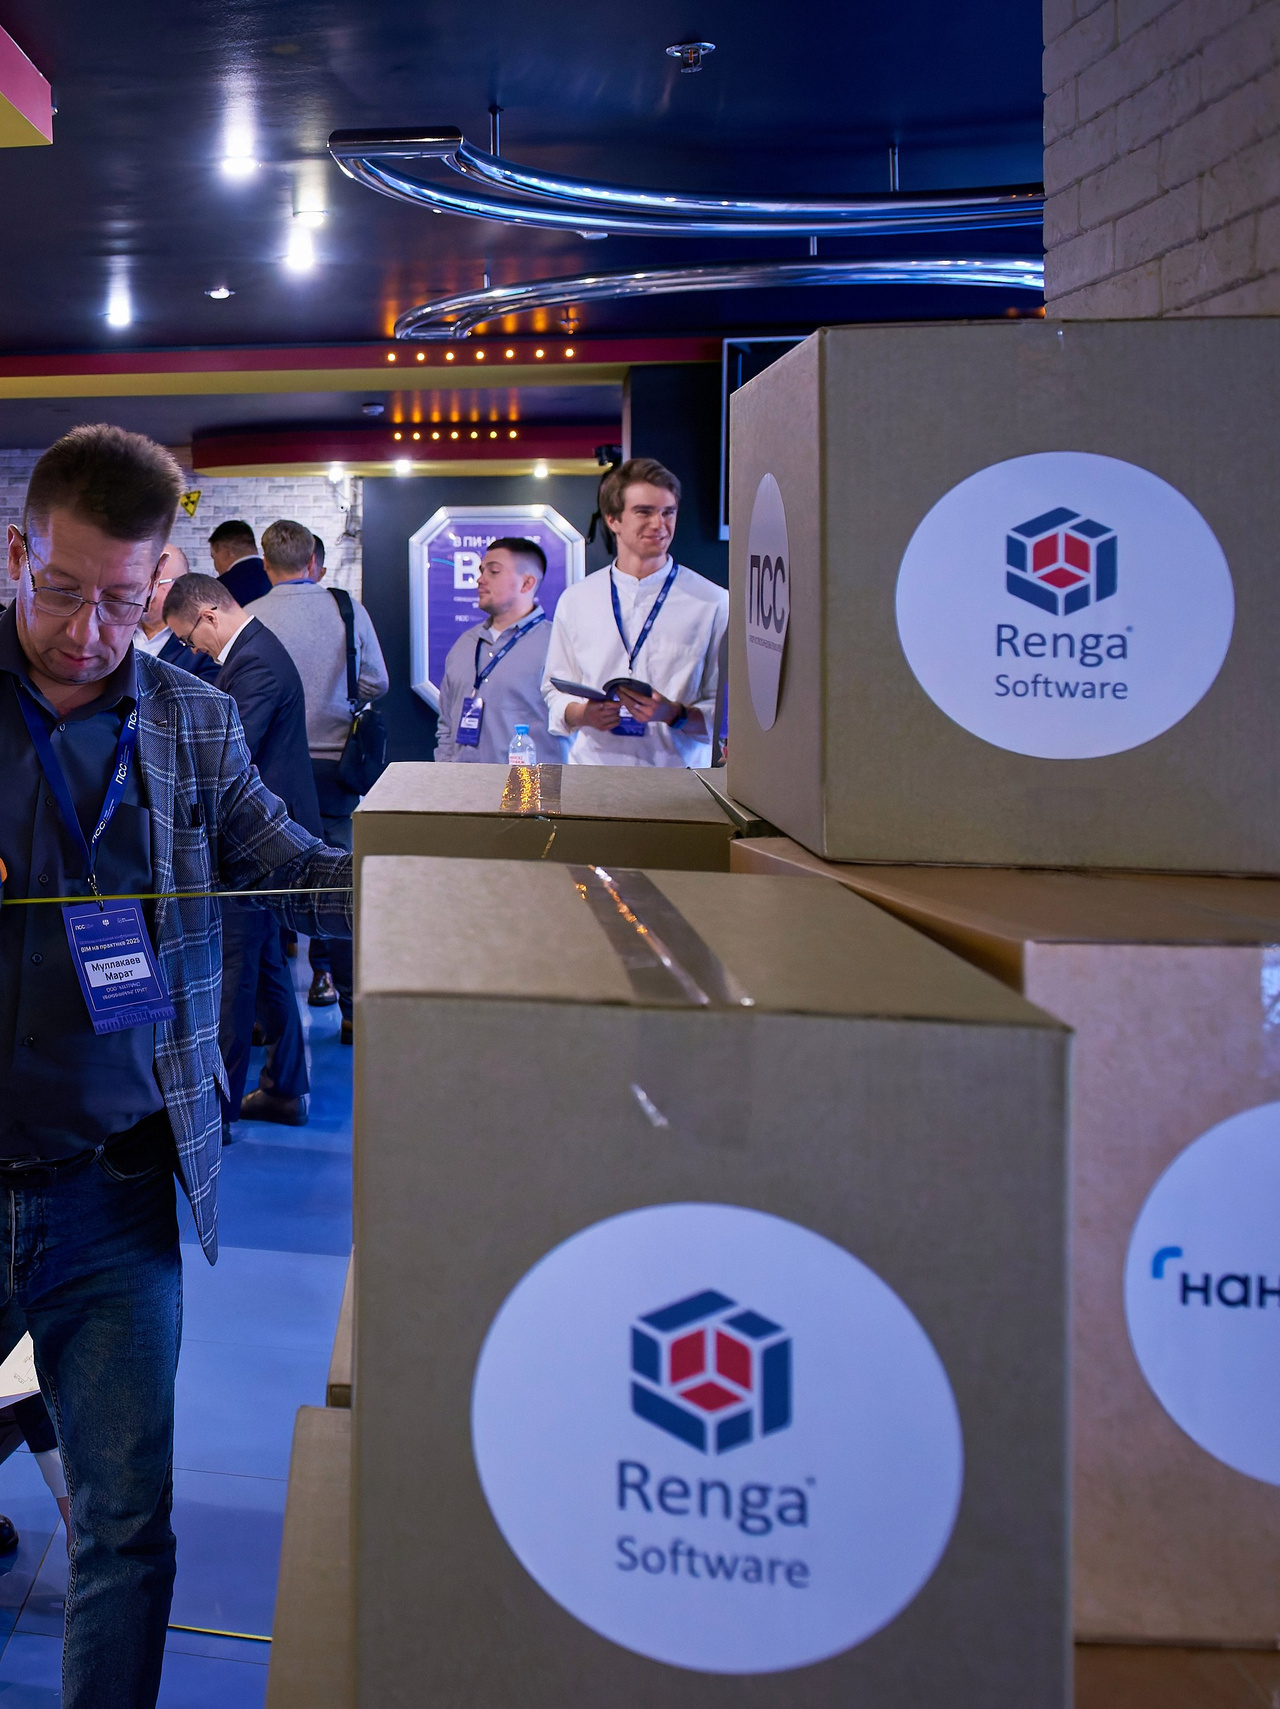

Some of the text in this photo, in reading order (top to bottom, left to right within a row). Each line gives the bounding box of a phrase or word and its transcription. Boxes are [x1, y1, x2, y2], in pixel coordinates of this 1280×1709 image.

[749, 554, 786, 634] ПСС
[996, 623, 1128, 667] Renga
[994, 673, 1129, 700] Software
[115, 763, 128, 785] ПСС
[91, 957, 141, 972] Муллакаев
[105, 969, 134, 981] Марат
[617, 1459, 810, 1536] Renga
[615, 1534, 811, 1589] Software
